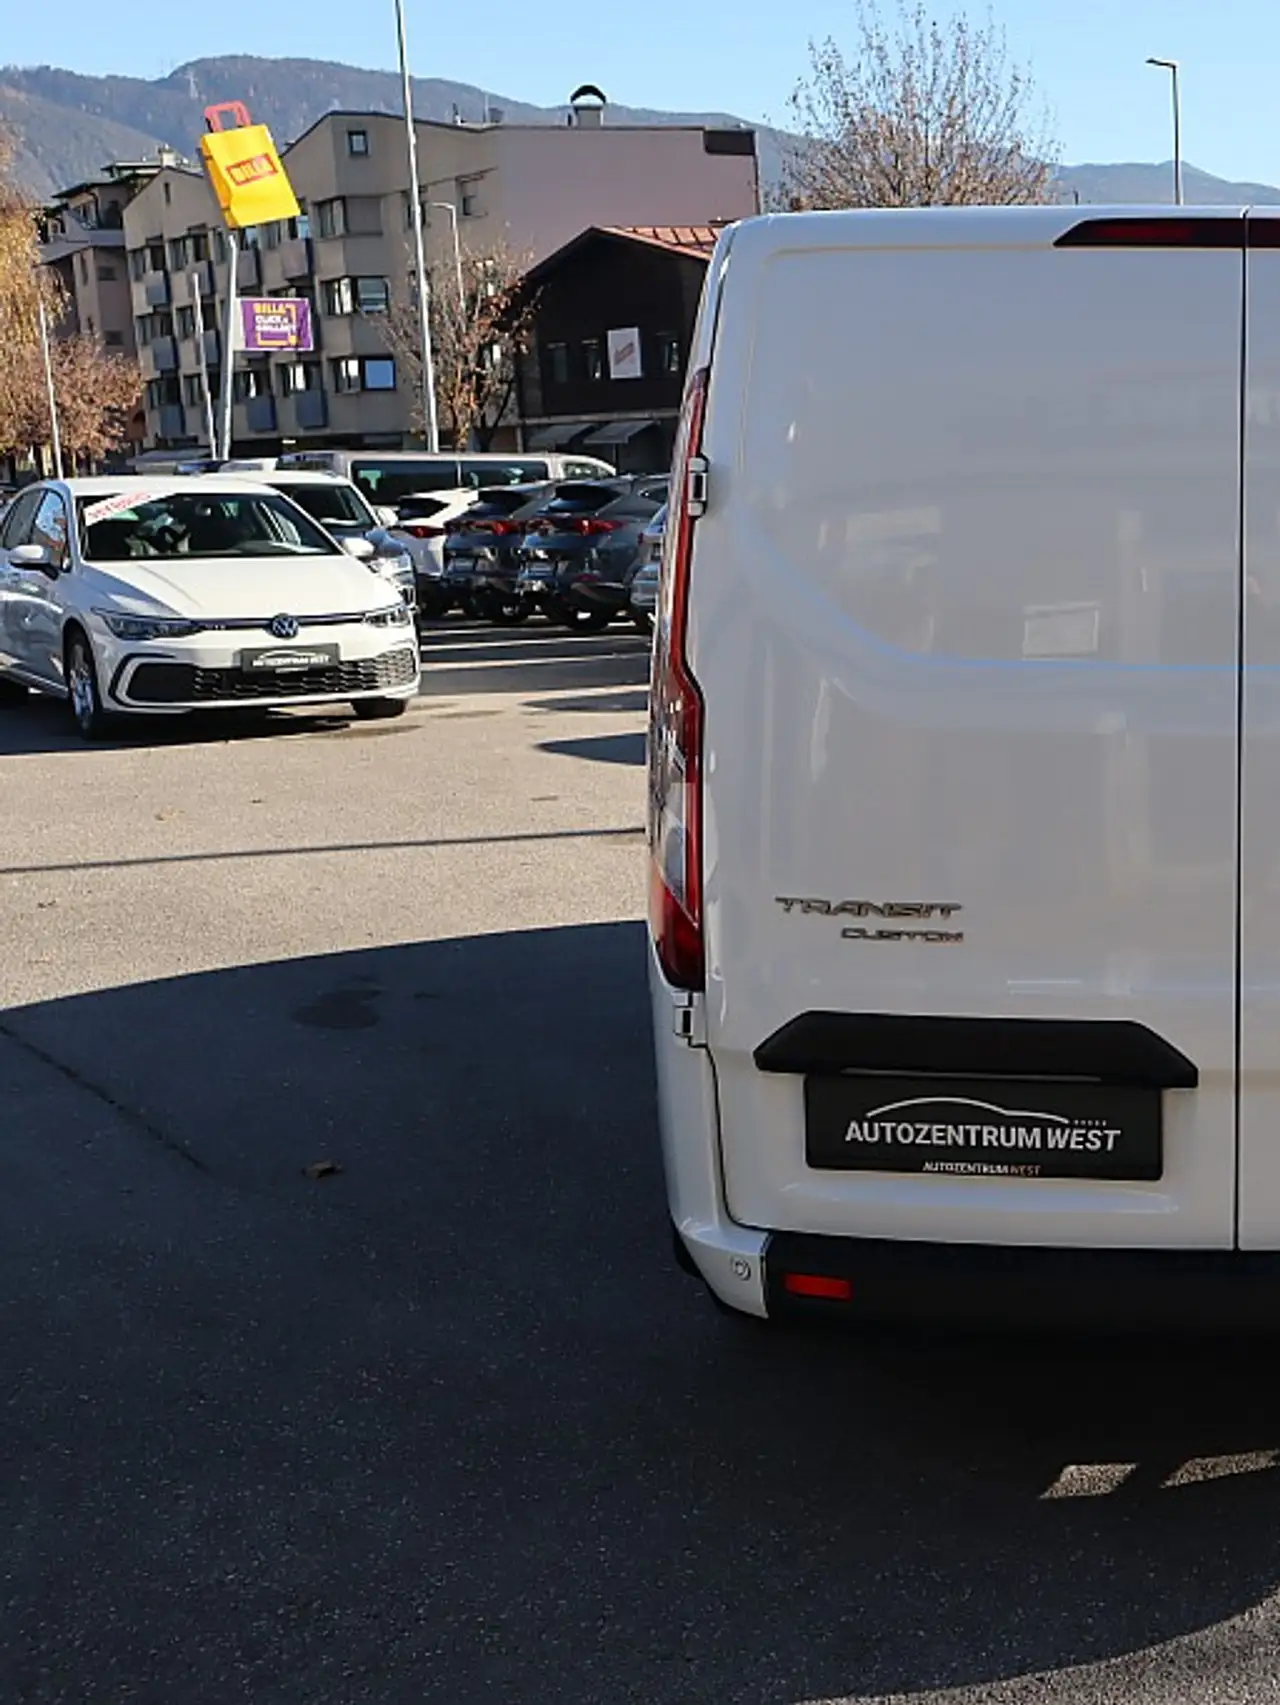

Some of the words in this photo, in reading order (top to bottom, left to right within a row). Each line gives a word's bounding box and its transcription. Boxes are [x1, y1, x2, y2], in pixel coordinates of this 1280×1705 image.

[253, 302, 287, 314] BILLA
[775, 896, 962, 919] TRANSIT
[841, 927, 964, 942] CUSTOM
[845, 1120, 1042, 1149] AUTOZENTRUM
[1046, 1127, 1122, 1151] WEST
